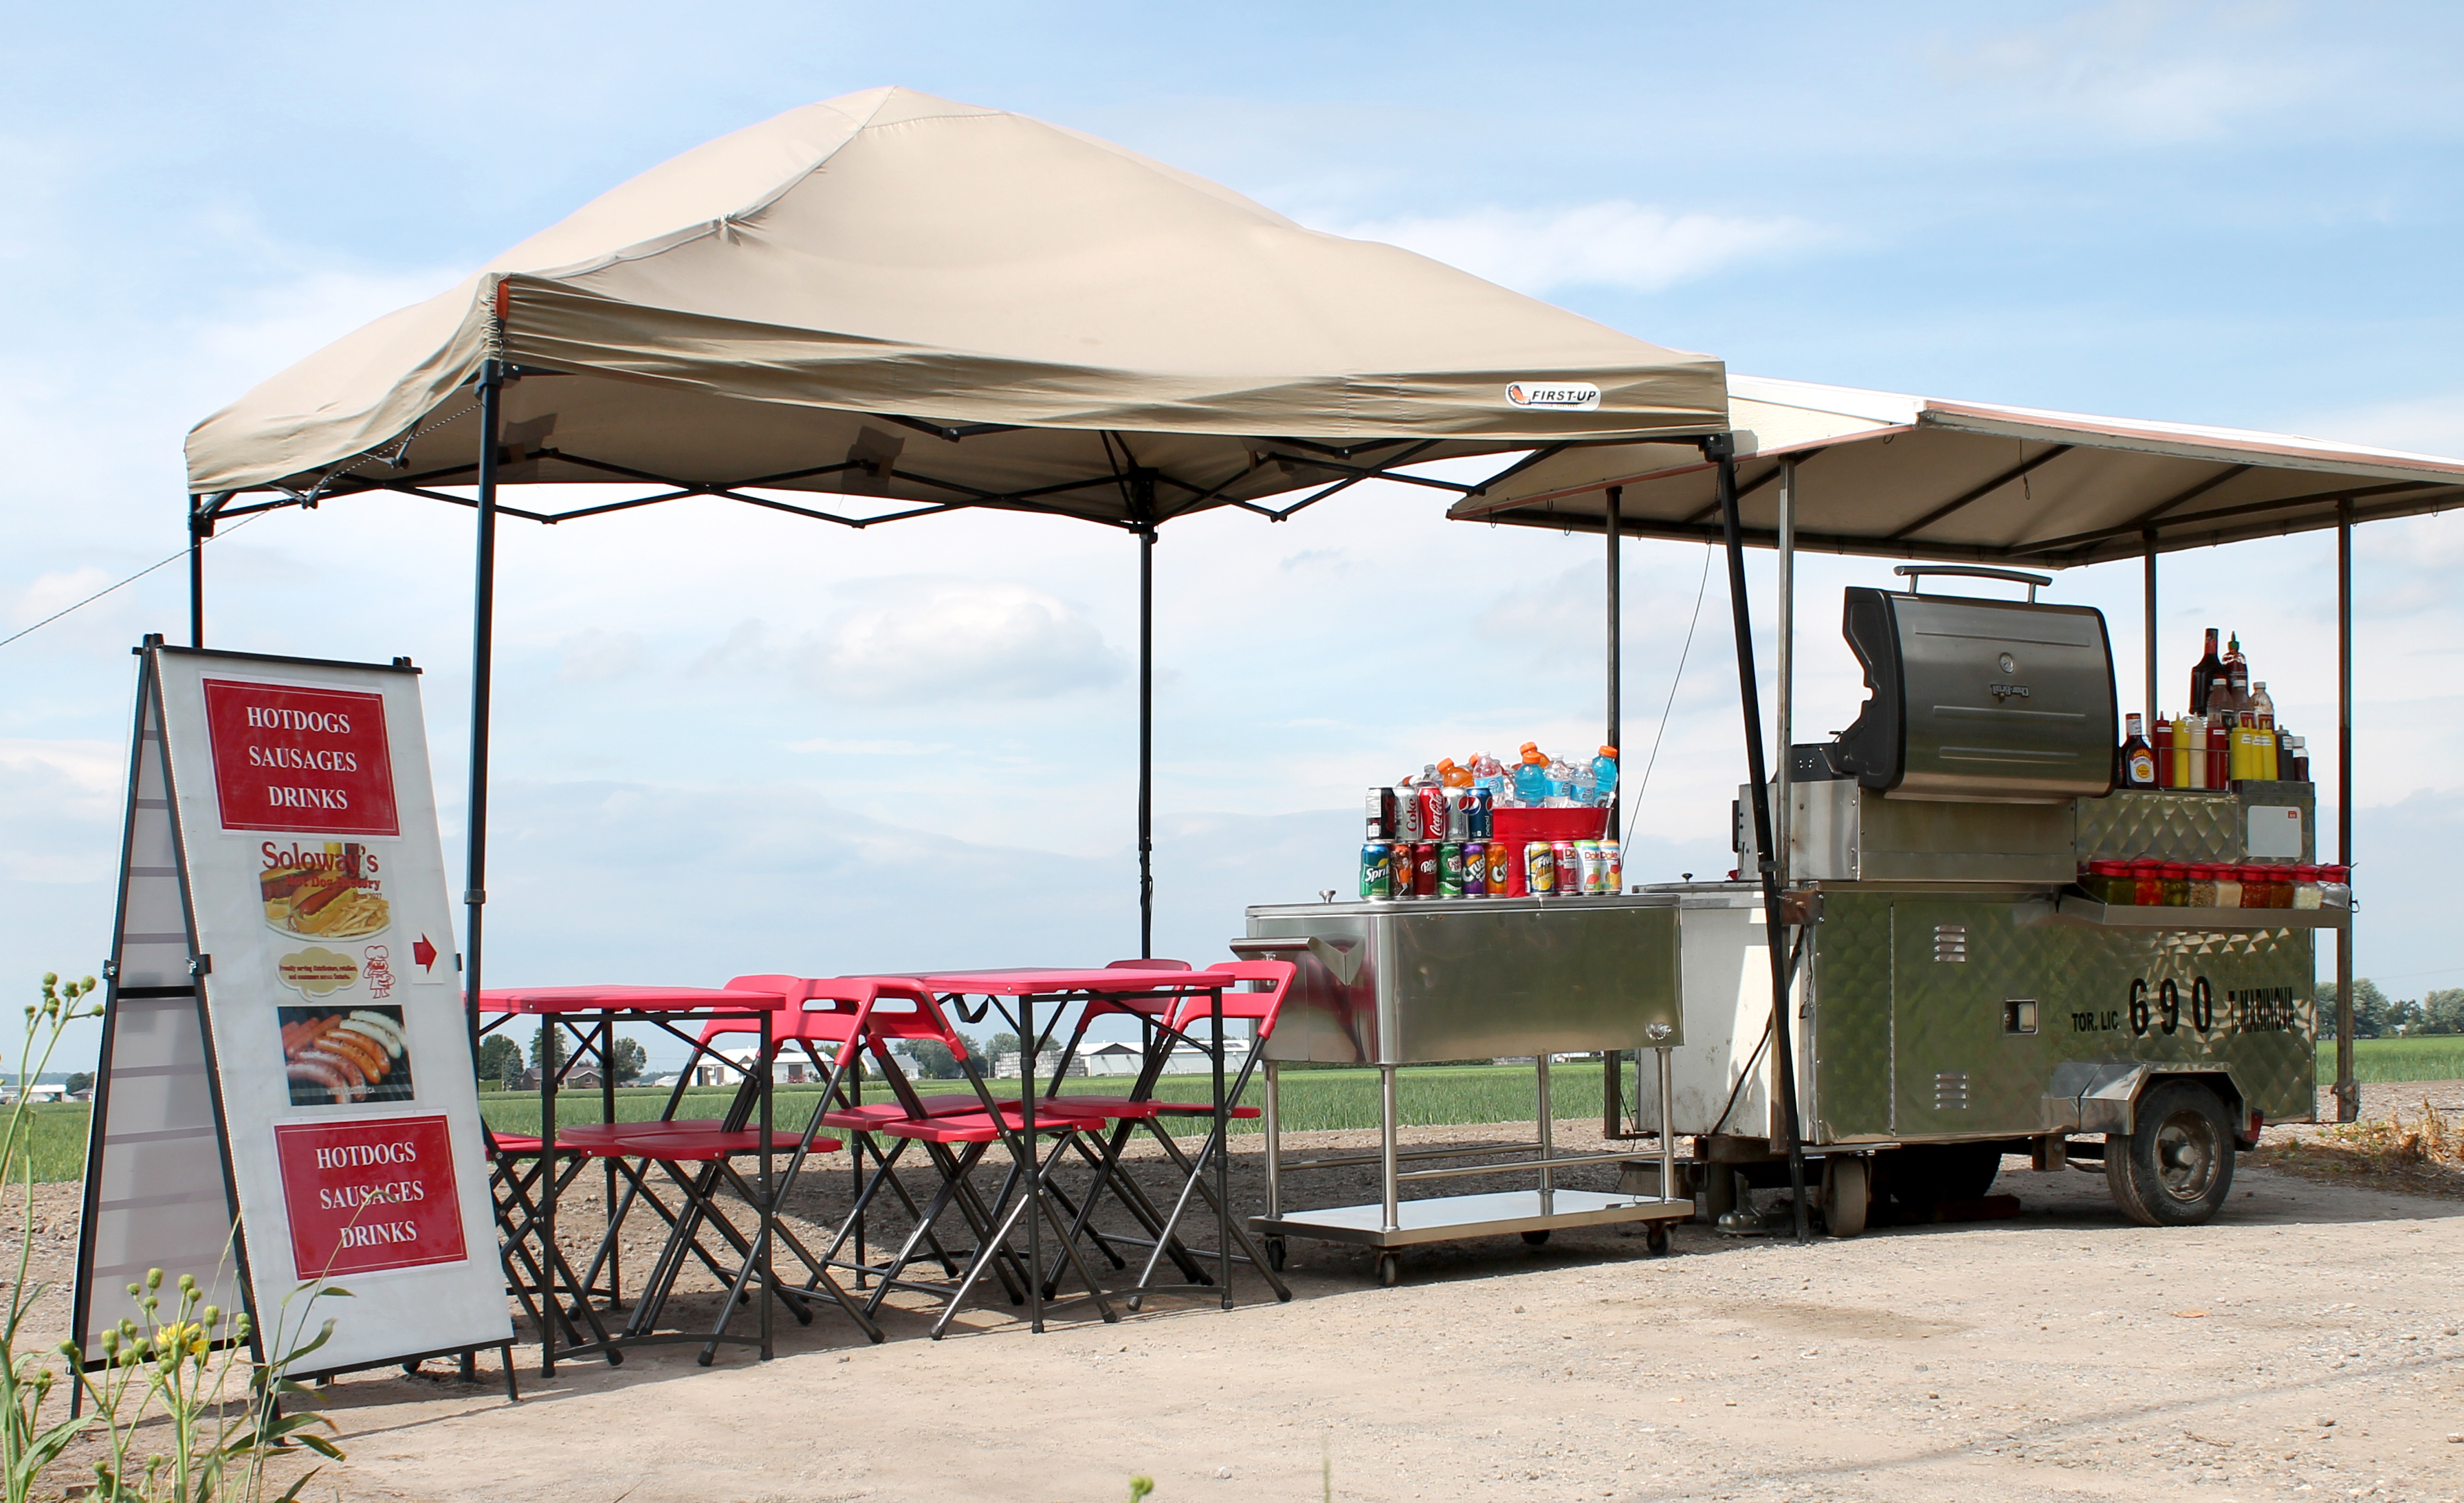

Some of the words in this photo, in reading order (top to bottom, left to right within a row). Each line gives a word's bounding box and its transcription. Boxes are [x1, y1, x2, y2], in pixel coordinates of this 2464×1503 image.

[246, 706, 351, 734] HOTDOGS
[248, 745, 358, 772] SAUSAGES
[268, 786, 349, 810] DRINKS
[1407, 798, 1417, 832] Coke
[1429, 791, 1443, 836] Coca-Cola
[261, 841, 379, 878] Soloway's
[1600, 851, 1618, 859] Dole
[2071, 1012, 2098, 1032] TOR.
[2100, 1011, 2118, 1031] LIC
[315, 1141, 417, 1169] HOTDOGS
[320, 1180, 424, 1210] SAUSAGES
[340, 1220, 417, 1249] DRINKS
